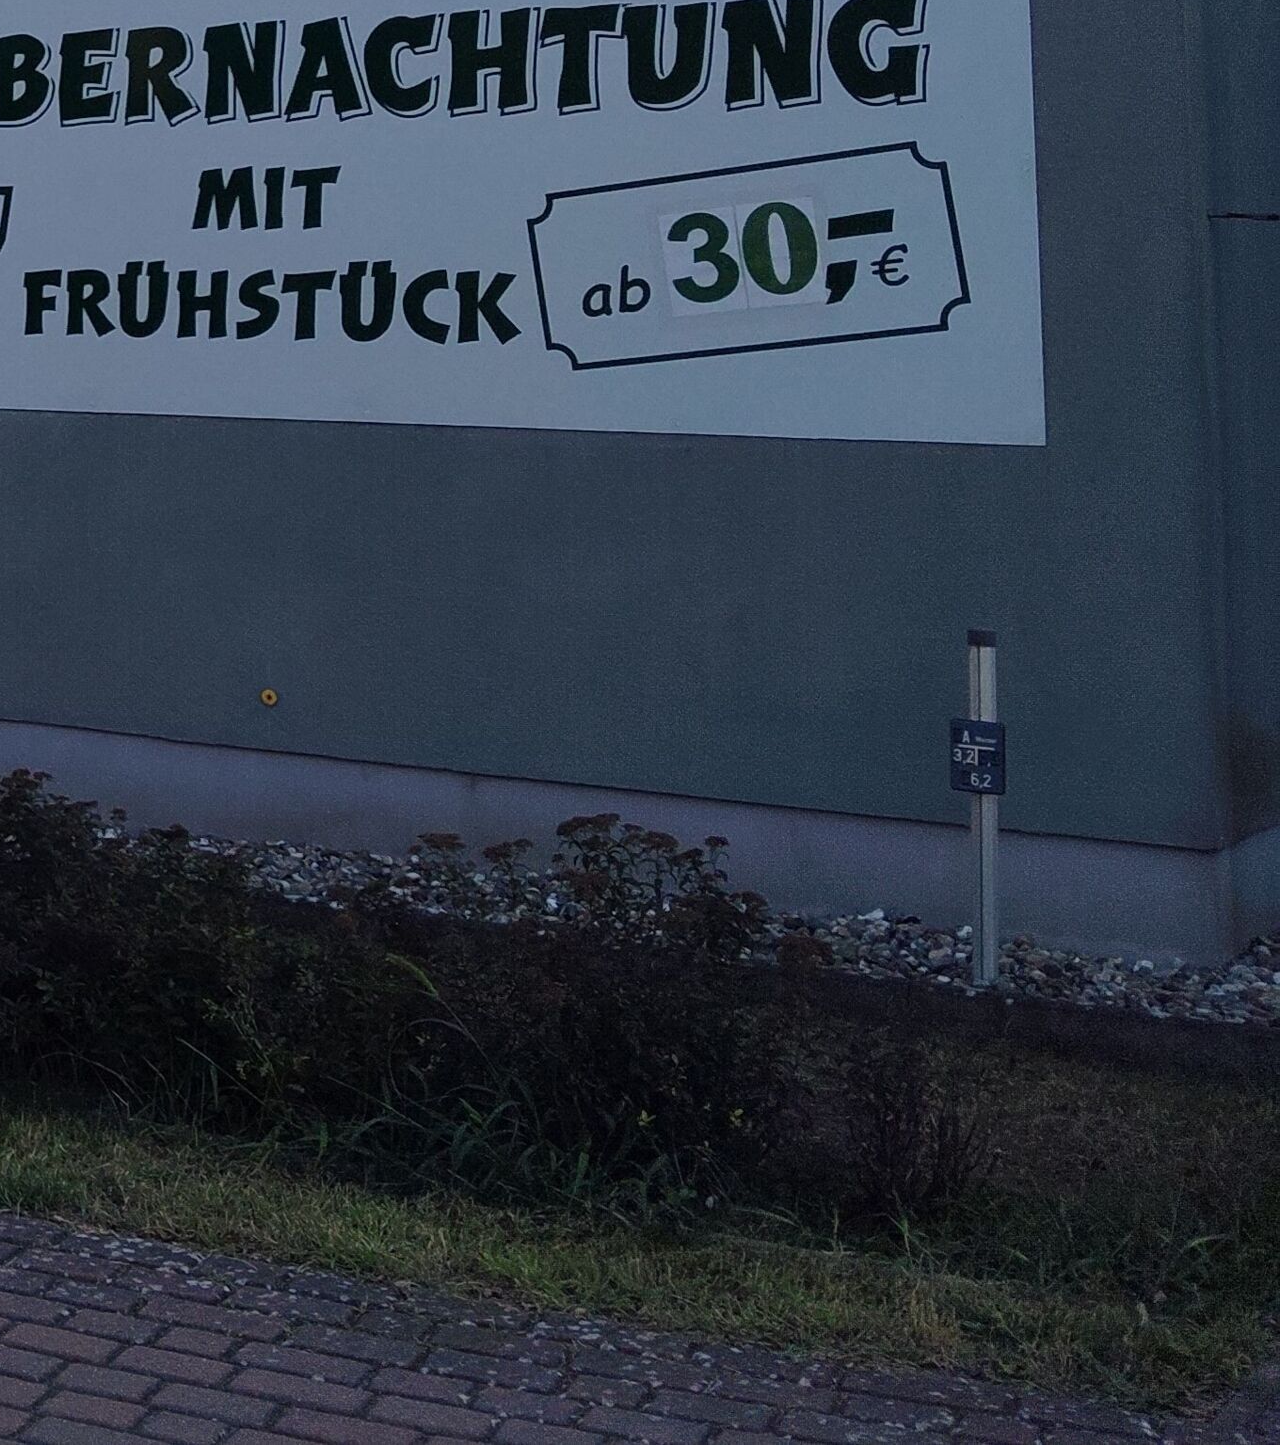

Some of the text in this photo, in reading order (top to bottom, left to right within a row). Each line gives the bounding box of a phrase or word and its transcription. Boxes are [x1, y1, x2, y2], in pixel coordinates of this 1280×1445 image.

[191, 165, 342, 231] MIT
[23, 259, 523, 346] FRÜHSTÜCK
[581, 264, 652, 318] ab
[962, 730, 971, 744] A
[970, 772, 993, 789] 6,2
